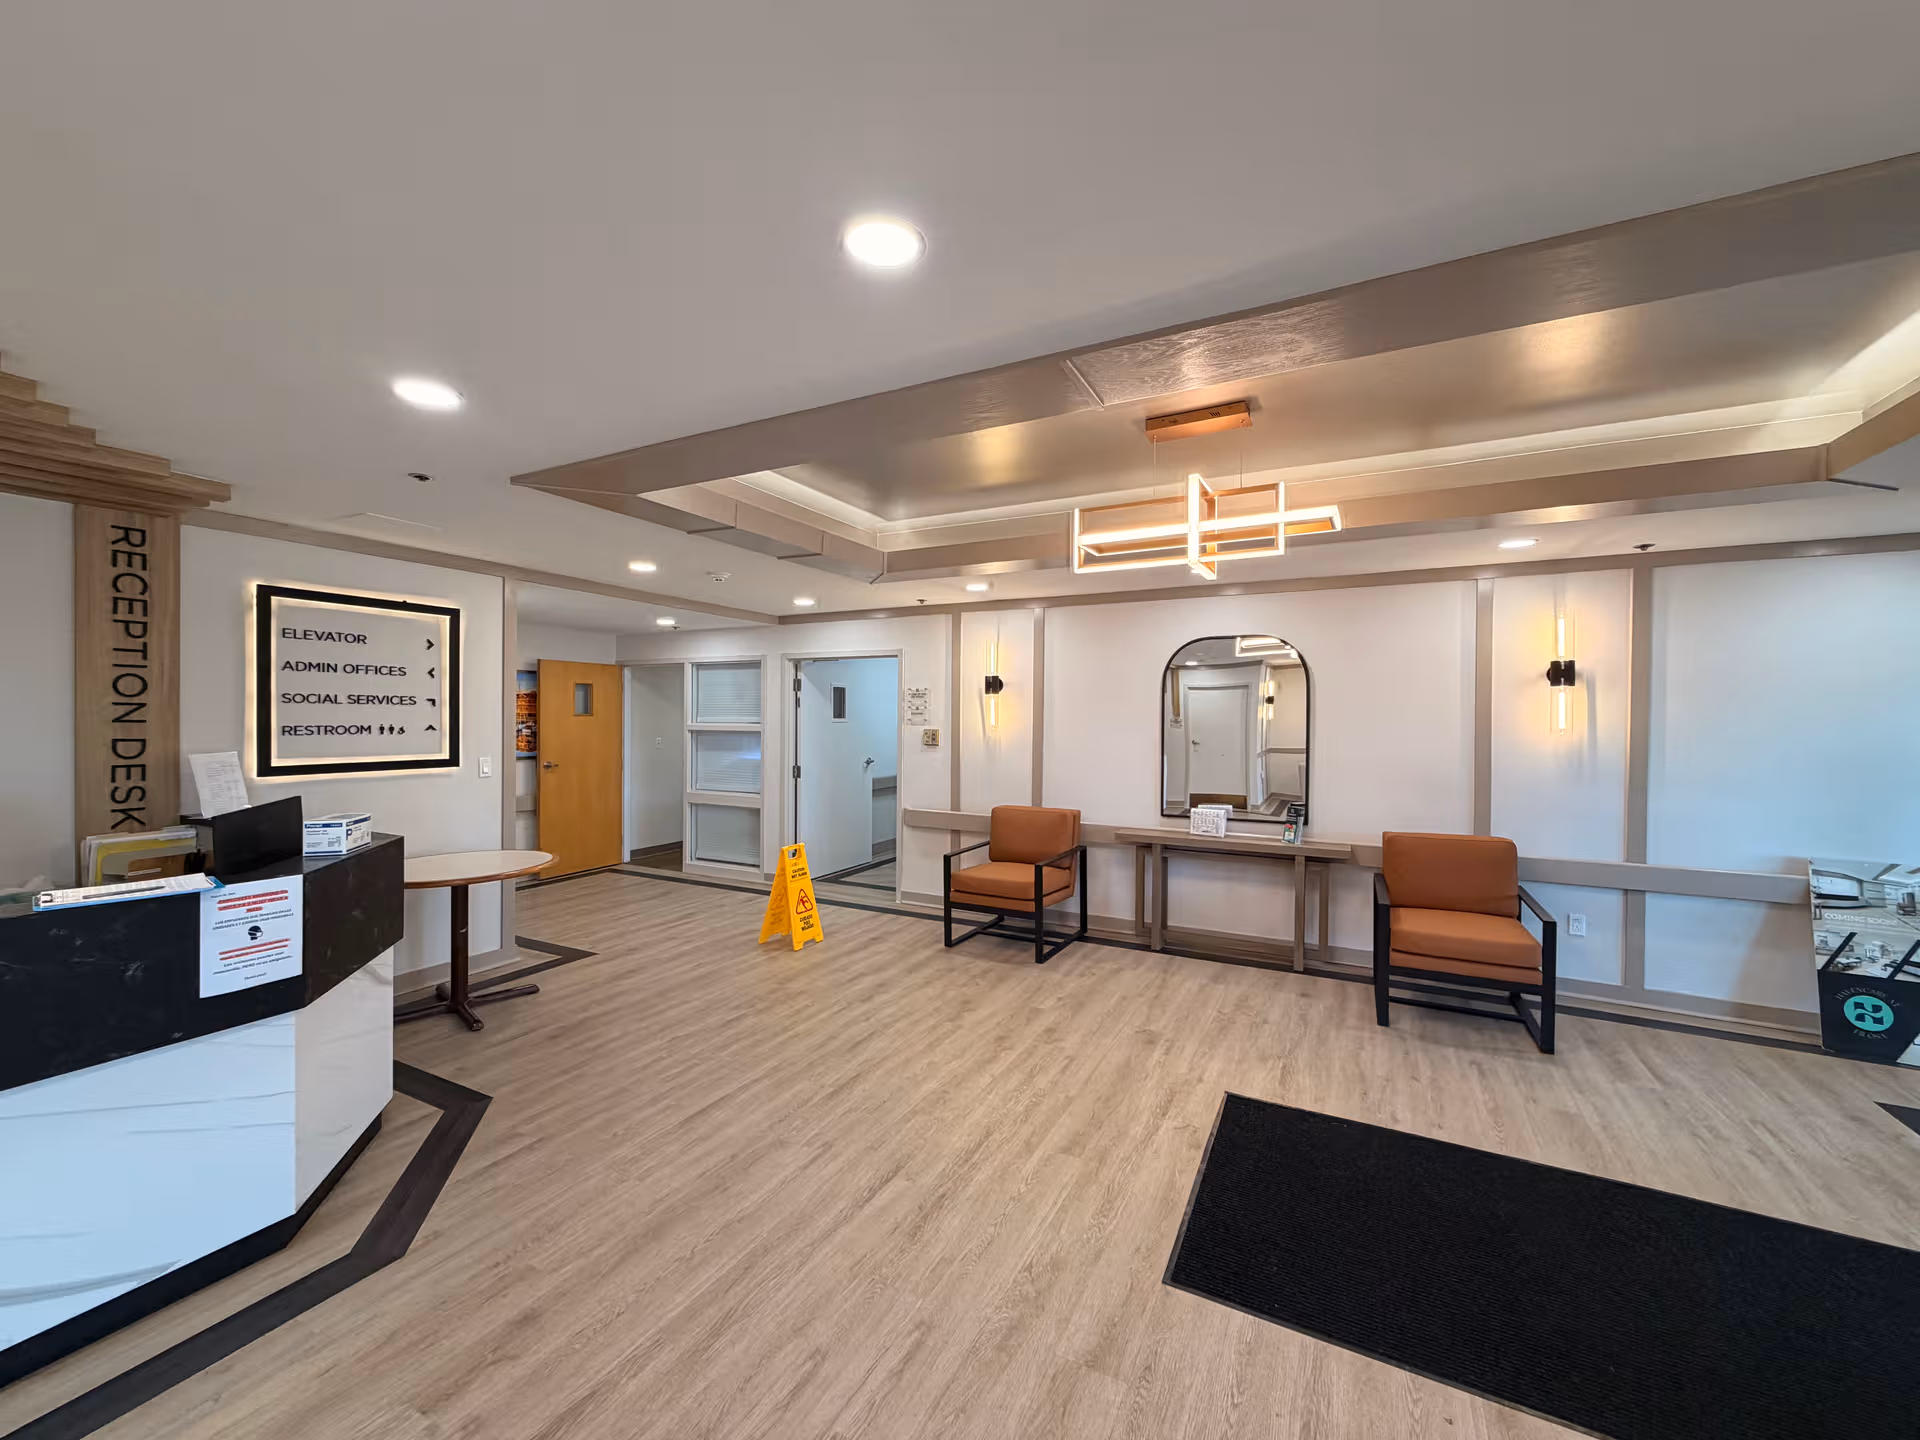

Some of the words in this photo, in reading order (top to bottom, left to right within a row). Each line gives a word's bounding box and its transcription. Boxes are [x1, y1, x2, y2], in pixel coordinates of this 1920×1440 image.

[110, 524, 148, 724] RECEPTION
[281, 627, 367, 645] ELEVATOR
[281, 660, 338, 674] ADMIN
[343, 663, 407, 677] OFFICES
[281, 692, 343, 705] SOCIAL
[347, 694, 417, 706] SERVICES
[281, 725, 372, 736] RESTROOM
[110, 738, 147, 830] DESK
[1824, 912, 1865, 923] COMING
